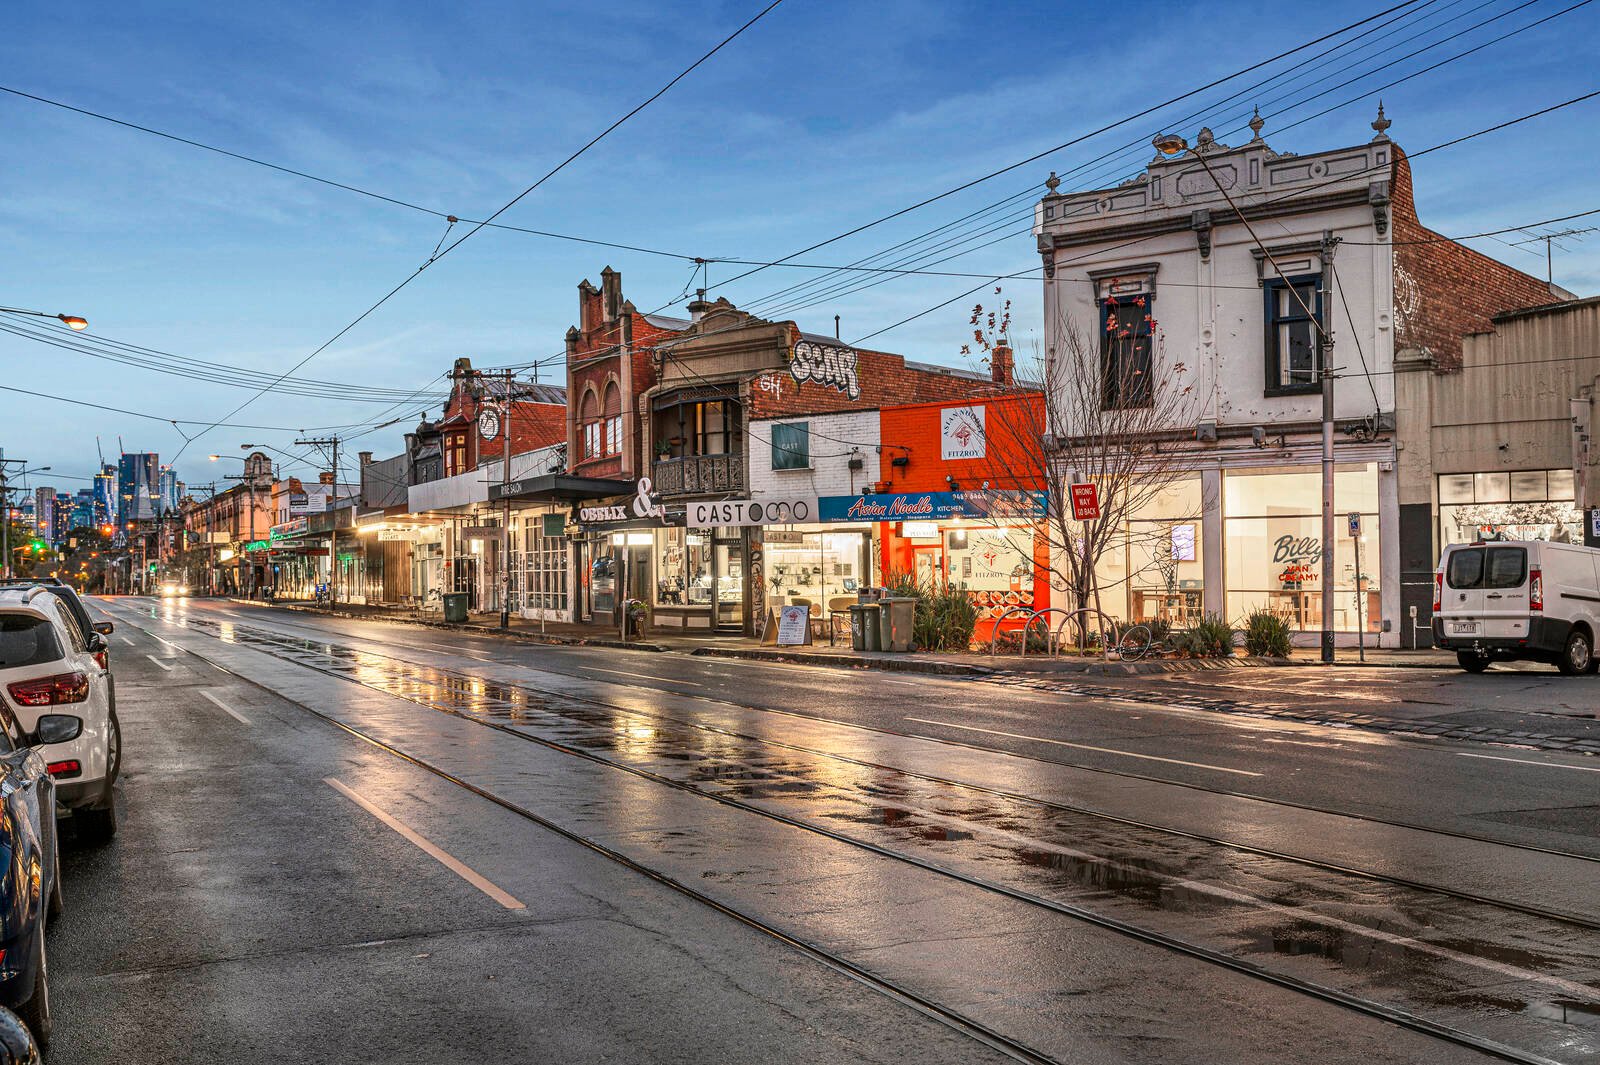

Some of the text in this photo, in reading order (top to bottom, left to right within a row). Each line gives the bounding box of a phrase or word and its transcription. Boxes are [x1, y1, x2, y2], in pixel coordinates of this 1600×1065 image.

[948, 450, 979, 458] FITZROY
[1075, 487, 1093, 496] WRONG
[1079, 497, 1091, 505] WAY
[848, 495, 933, 517] Asian Noodle
[580, 505, 627, 521] OBELIX
[696, 504, 743, 523] CAST
[1084, 507, 1097, 515] BACK
[1273, 534, 1322, 564] Billy
[1287, 565, 1309, 573] VAN
[1278, 573, 1319, 582] CREAMY
